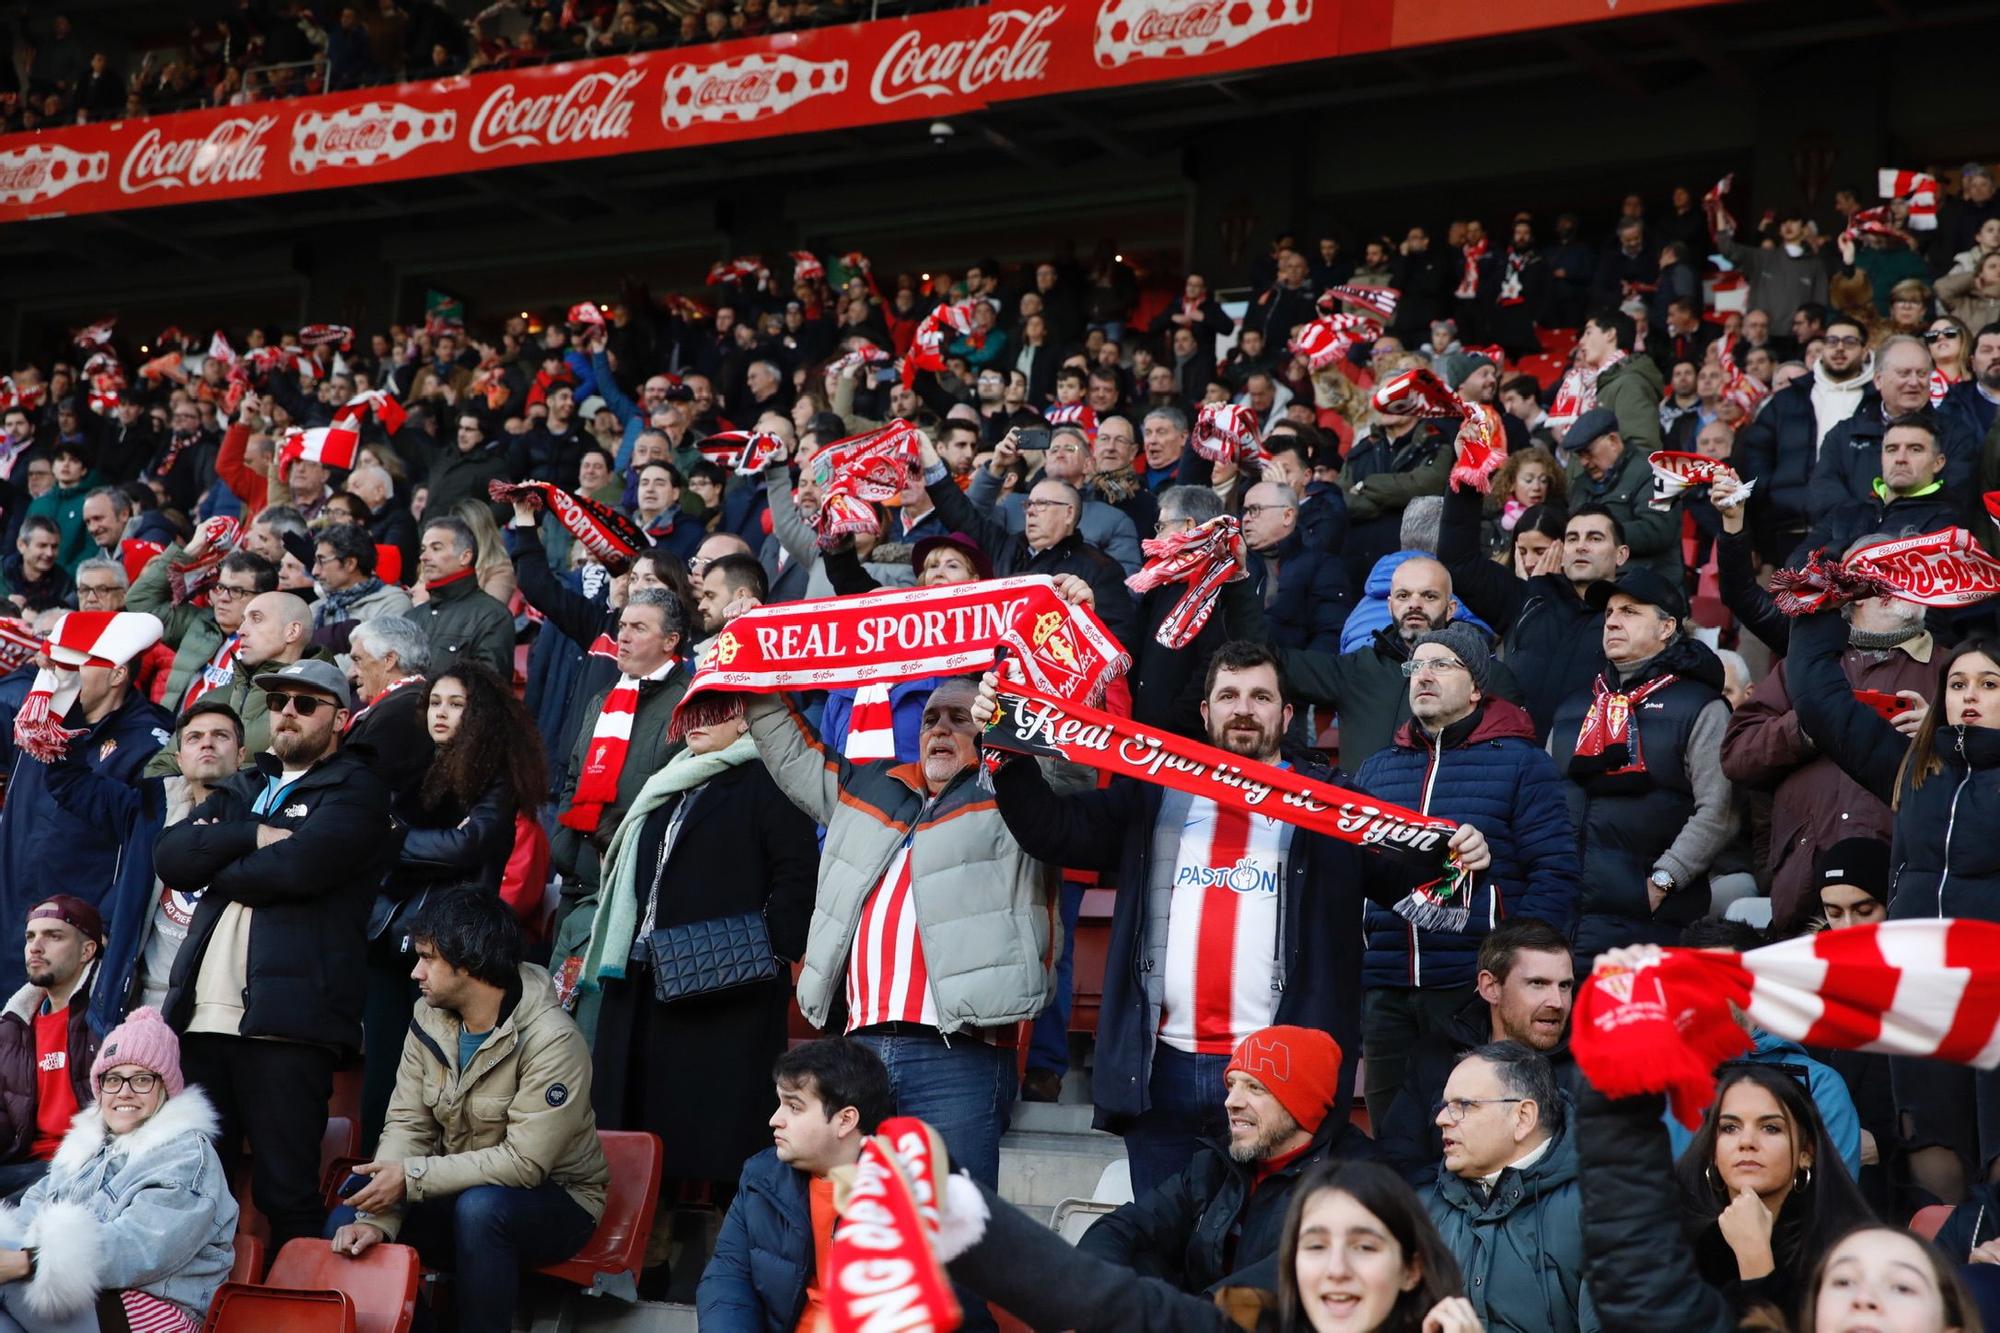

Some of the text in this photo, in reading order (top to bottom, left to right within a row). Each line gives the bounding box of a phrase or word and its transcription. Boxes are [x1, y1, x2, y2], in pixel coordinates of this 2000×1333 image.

[756, 595, 1029, 661] REAL SPORTING
[1013, 697, 1115, 752] Real
[1119, 732, 1273, 805] Sporting
[1282, 789, 1328, 812] de
[164, 901, 175, 915] NO
